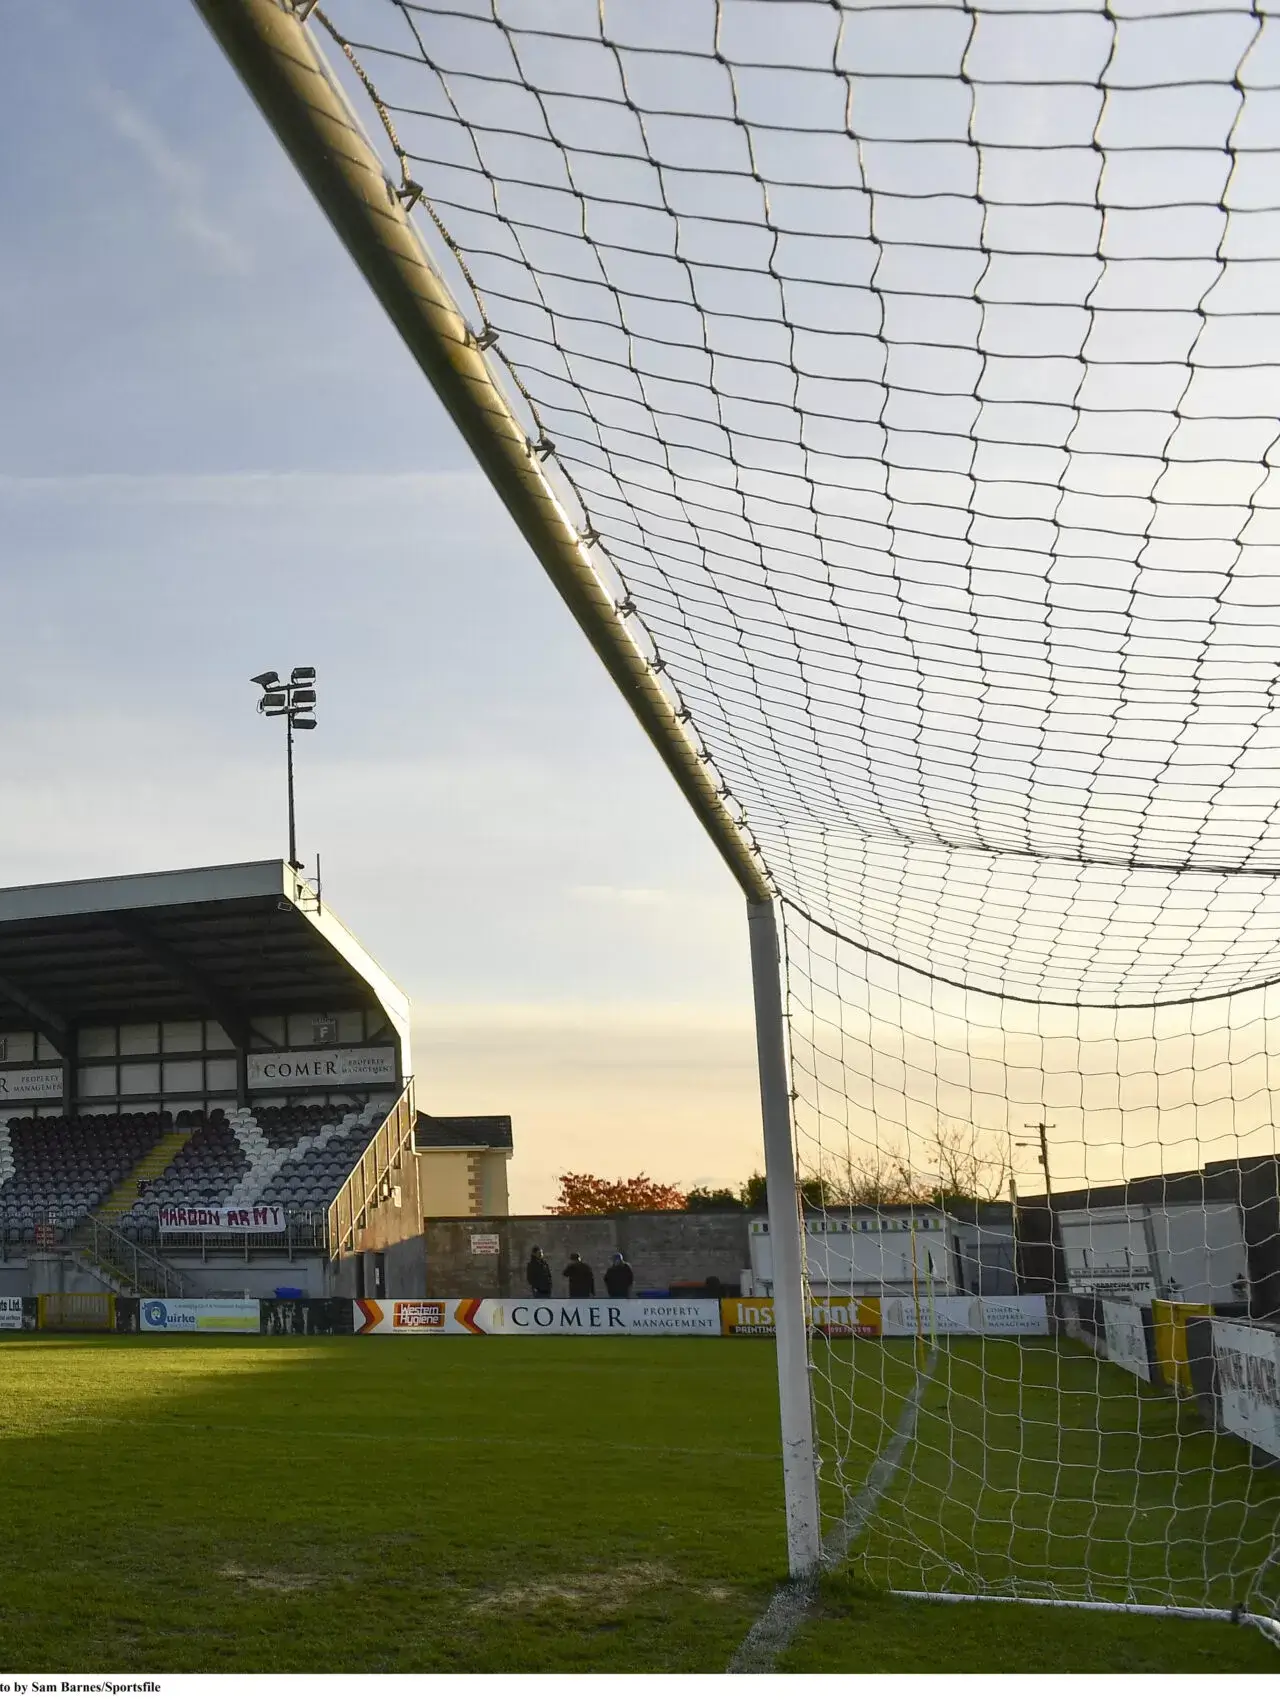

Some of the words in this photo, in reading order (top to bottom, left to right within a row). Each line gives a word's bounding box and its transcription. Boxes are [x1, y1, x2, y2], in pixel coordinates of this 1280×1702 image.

[264, 1060, 338, 1078] COMER
[21, 1075, 59, 1083] PROPERTY
[13, 1083, 63, 1093] MANAGEMEN
[159, 1208, 220, 1226] MAROON
[227, 1206, 280, 1225] ARMY
[8, 1299, 21, 1311] Ltd.
[401, 1301, 439, 1314] Western
[144, 1301, 195, 1327] Quirke
[511, 1306, 627, 1327] COMER
[643, 1307, 701, 1317] PROPERTY
[400, 1315, 439, 1326] Hygiene
[632, 1319, 714, 1328] MANAGEMENT
